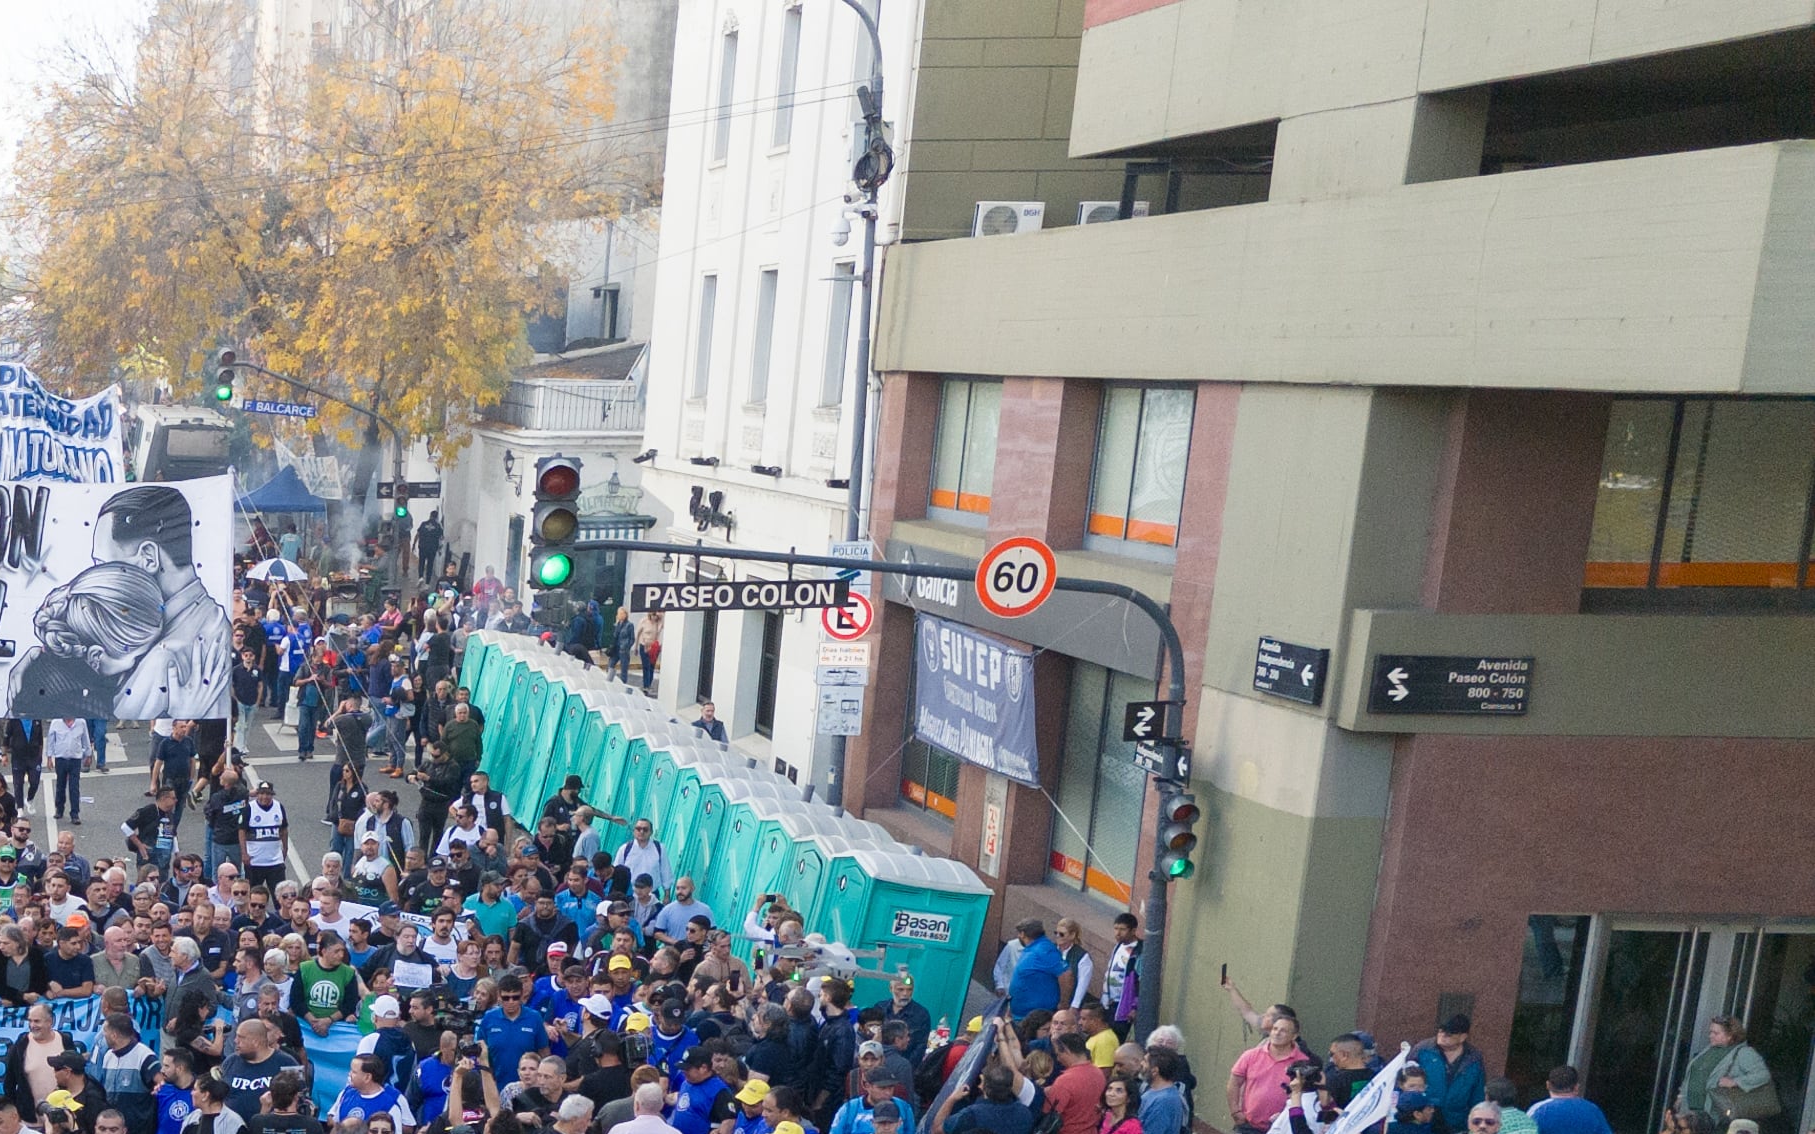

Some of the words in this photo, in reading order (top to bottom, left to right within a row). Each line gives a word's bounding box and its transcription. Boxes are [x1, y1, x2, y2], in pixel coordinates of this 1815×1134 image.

[257, 402, 316, 417] BALCARCE
[993, 561, 1039, 594] 60
[644, 585, 735, 609] PASEO
[741, 583, 836, 607] COLON
[940, 627, 1003, 691] SUTEP
[1477, 660, 1529, 671] Avenida
[1448, 672, 1486, 683] Paseo
[1489, 672, 1526, 684] Colón
[1467, 688, 1490, 698] 800
[1502, 688, 1524, 698] 750
[897, 913, 951, 933] Basani
[310, 985, 338, 1004] ATE
[231, 1076, 273, 1091] UPCN
